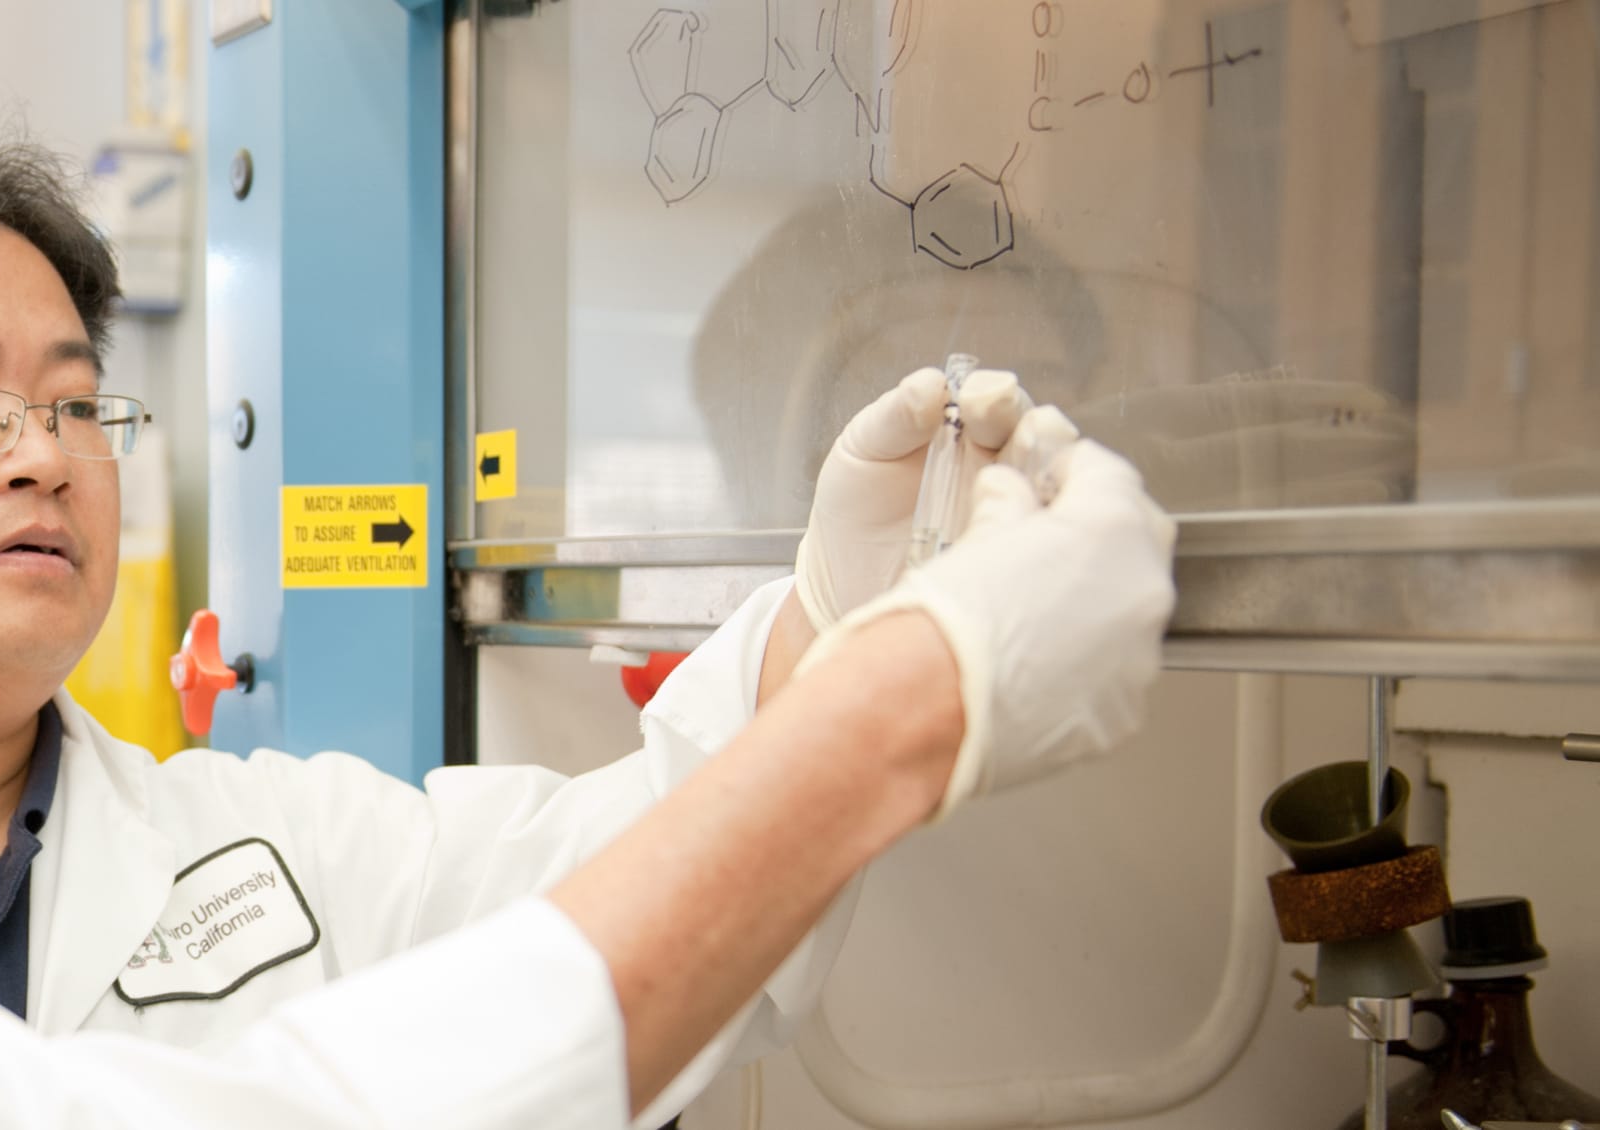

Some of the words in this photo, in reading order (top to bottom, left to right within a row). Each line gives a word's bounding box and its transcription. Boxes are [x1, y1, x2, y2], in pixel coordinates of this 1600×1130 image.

[854, 87, 883, 138] N
[304, 495, 343, 512] MATCH
[348, 494, 397, 511] ARROWS
[294, 525, 308, 542] TO
[313, 525, 356, 542] ASSURE
[284, 555, 342, 573] ADEQUATE
[346, 554, 417, 572] VENTILATION
[190, 869, 277, 925] University
[185, 903, 266, 961] California
